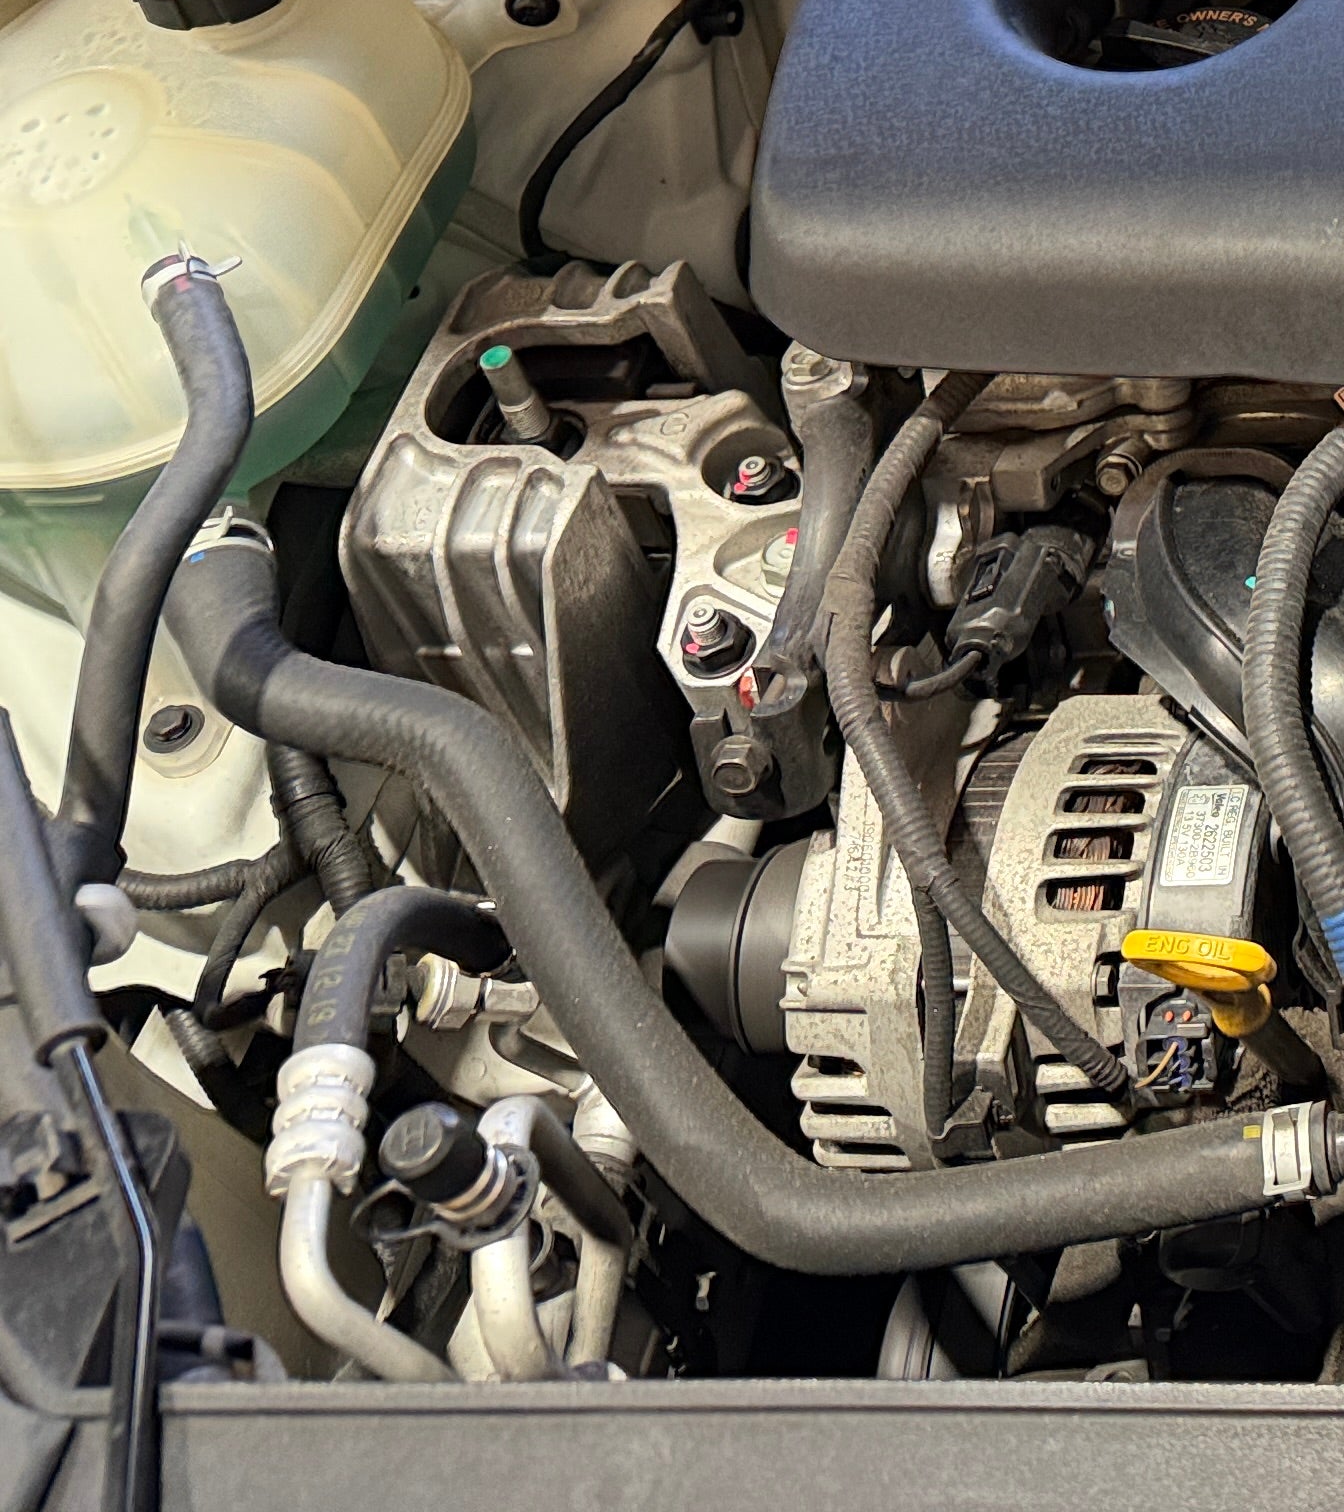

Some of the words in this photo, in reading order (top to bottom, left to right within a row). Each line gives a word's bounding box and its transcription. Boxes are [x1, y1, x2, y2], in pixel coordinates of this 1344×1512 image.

[1177, 10, 1258, 27] OWNER'S
[1211, 792, 1228, 818] Valeo
[1198, 823, 1220, 873] 2622503
[1219, 829, 1234, 857] BUILT
[1145, 935, 1191, 955] ENG
[1198, 939, 1231, 961] OIL
